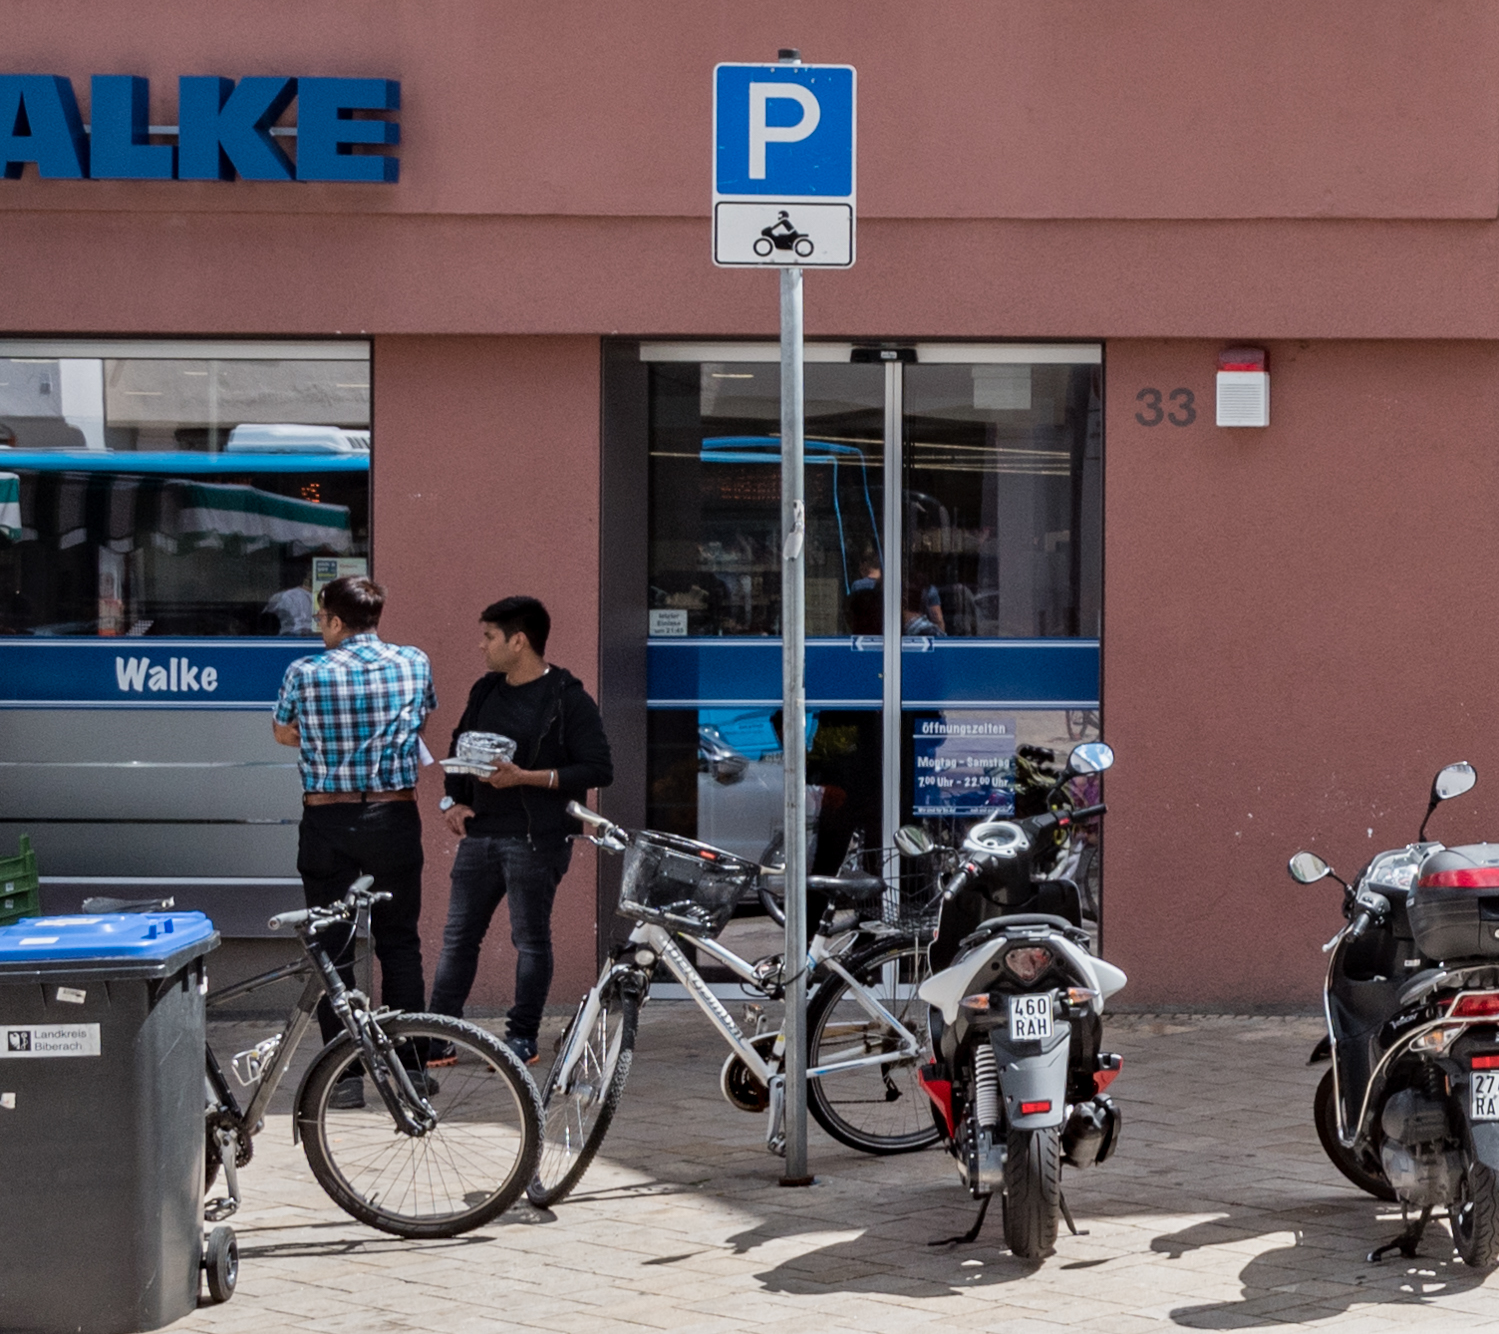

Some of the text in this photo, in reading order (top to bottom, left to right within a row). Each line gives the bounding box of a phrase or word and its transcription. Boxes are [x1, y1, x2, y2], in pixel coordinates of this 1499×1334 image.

[749, 82, 821, 179] P
[1135, 387, 1197, 427] 33
[116, 656, 218, 692] Walke
[967, 757, 1010, 769] Samstag
[937, 777, 954, 787] Uhr
[992, 777, 1009, 787] Uhr
[1015, 998, 1046, 1016] 460
[34, 1030, 87, 1039] Landkreis
[1016, 1018, 1047, 1036] RAH
[34, 1042, 83, 1051] Biberach
